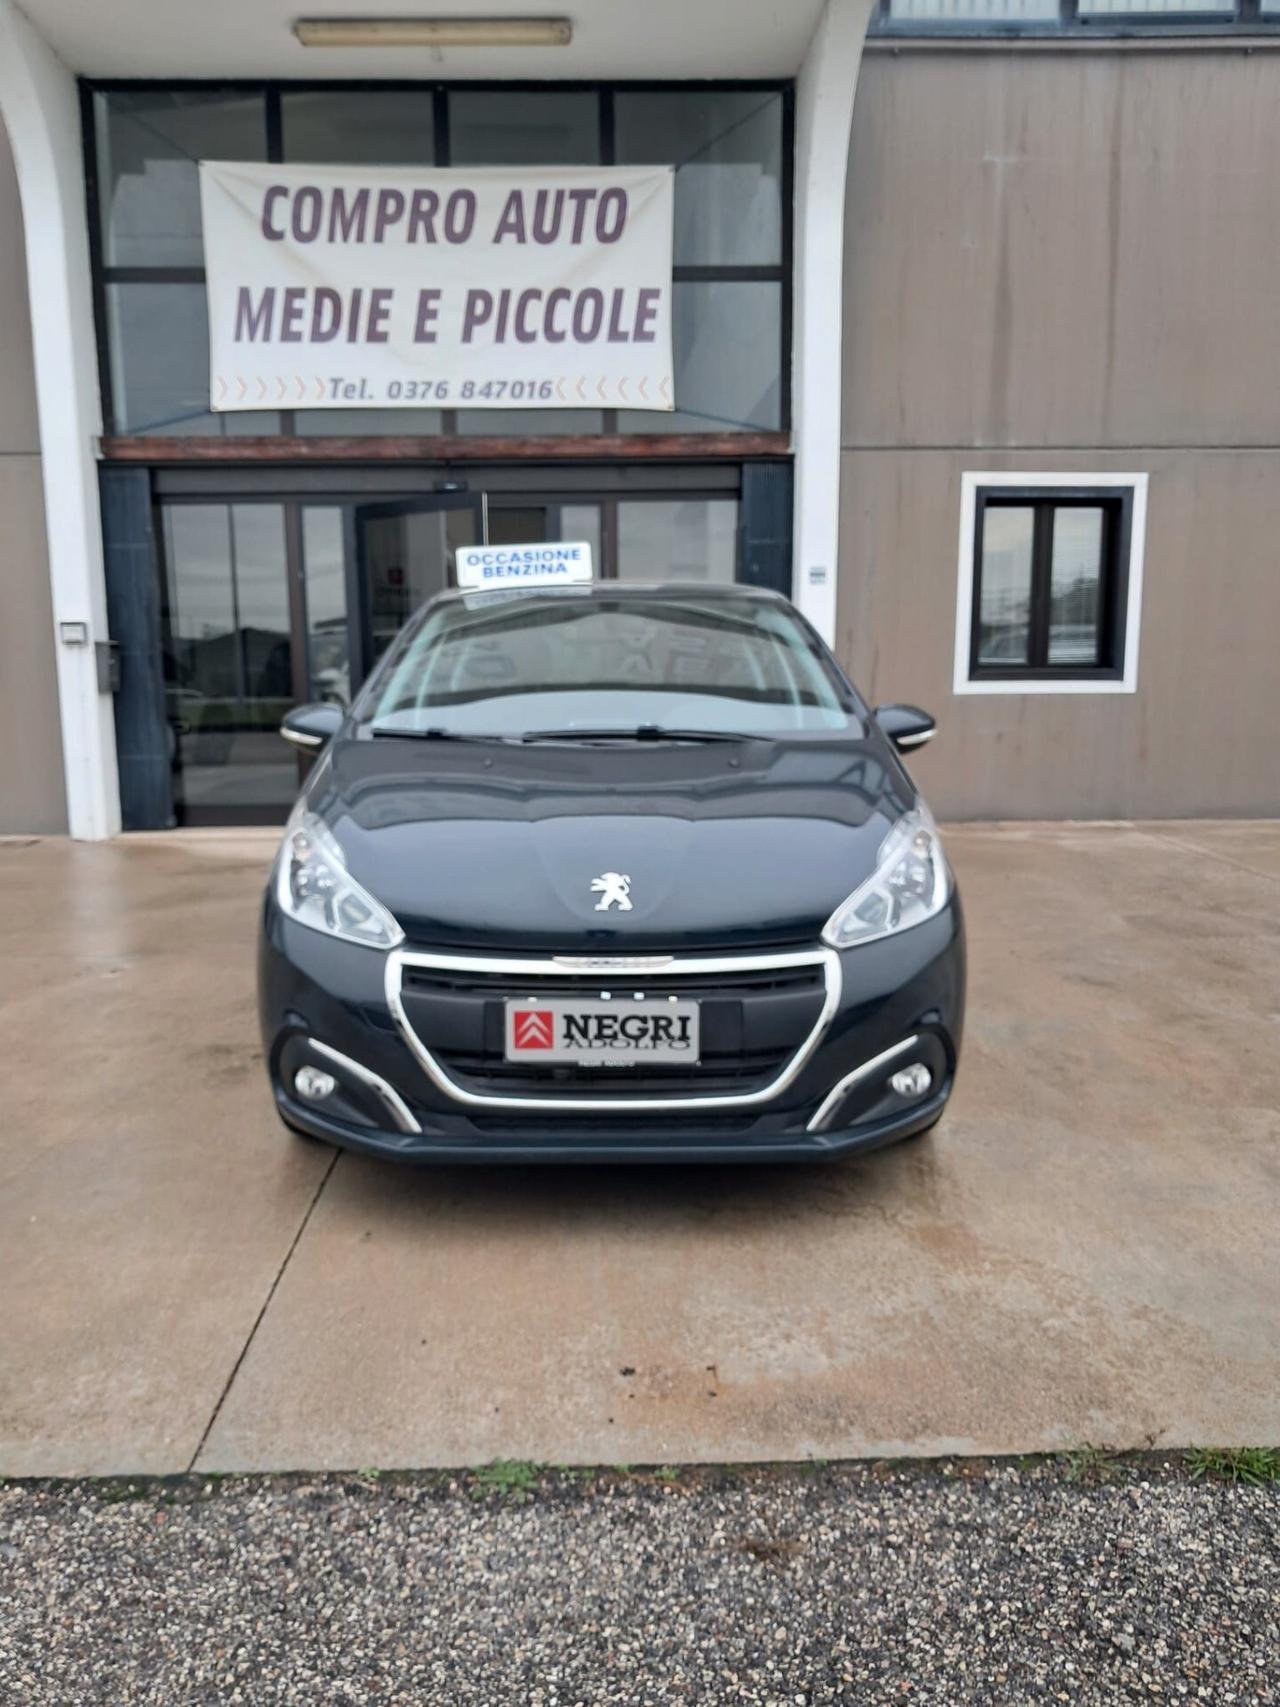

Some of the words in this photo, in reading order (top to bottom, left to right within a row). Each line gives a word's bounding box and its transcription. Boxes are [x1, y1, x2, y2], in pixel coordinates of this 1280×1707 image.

[261, 184, 477, 245] COMPRO
[493, 186, 629, 245] AUTO
[233, 286, 394, 343] MEDIE
[413, 289, 441, 343] E
[461, 287, 661, 344] PICCOLE
[329, 377, 374, 399] Tel.
[388, 380, 448, 400] 0376
[460, 380, 553, 400] 847016
[467, 549, 581, 566] OCCASIONE
[483, 563, 568, 577] BENZINA
[563, 1014, 691, 1041] NEGRI
